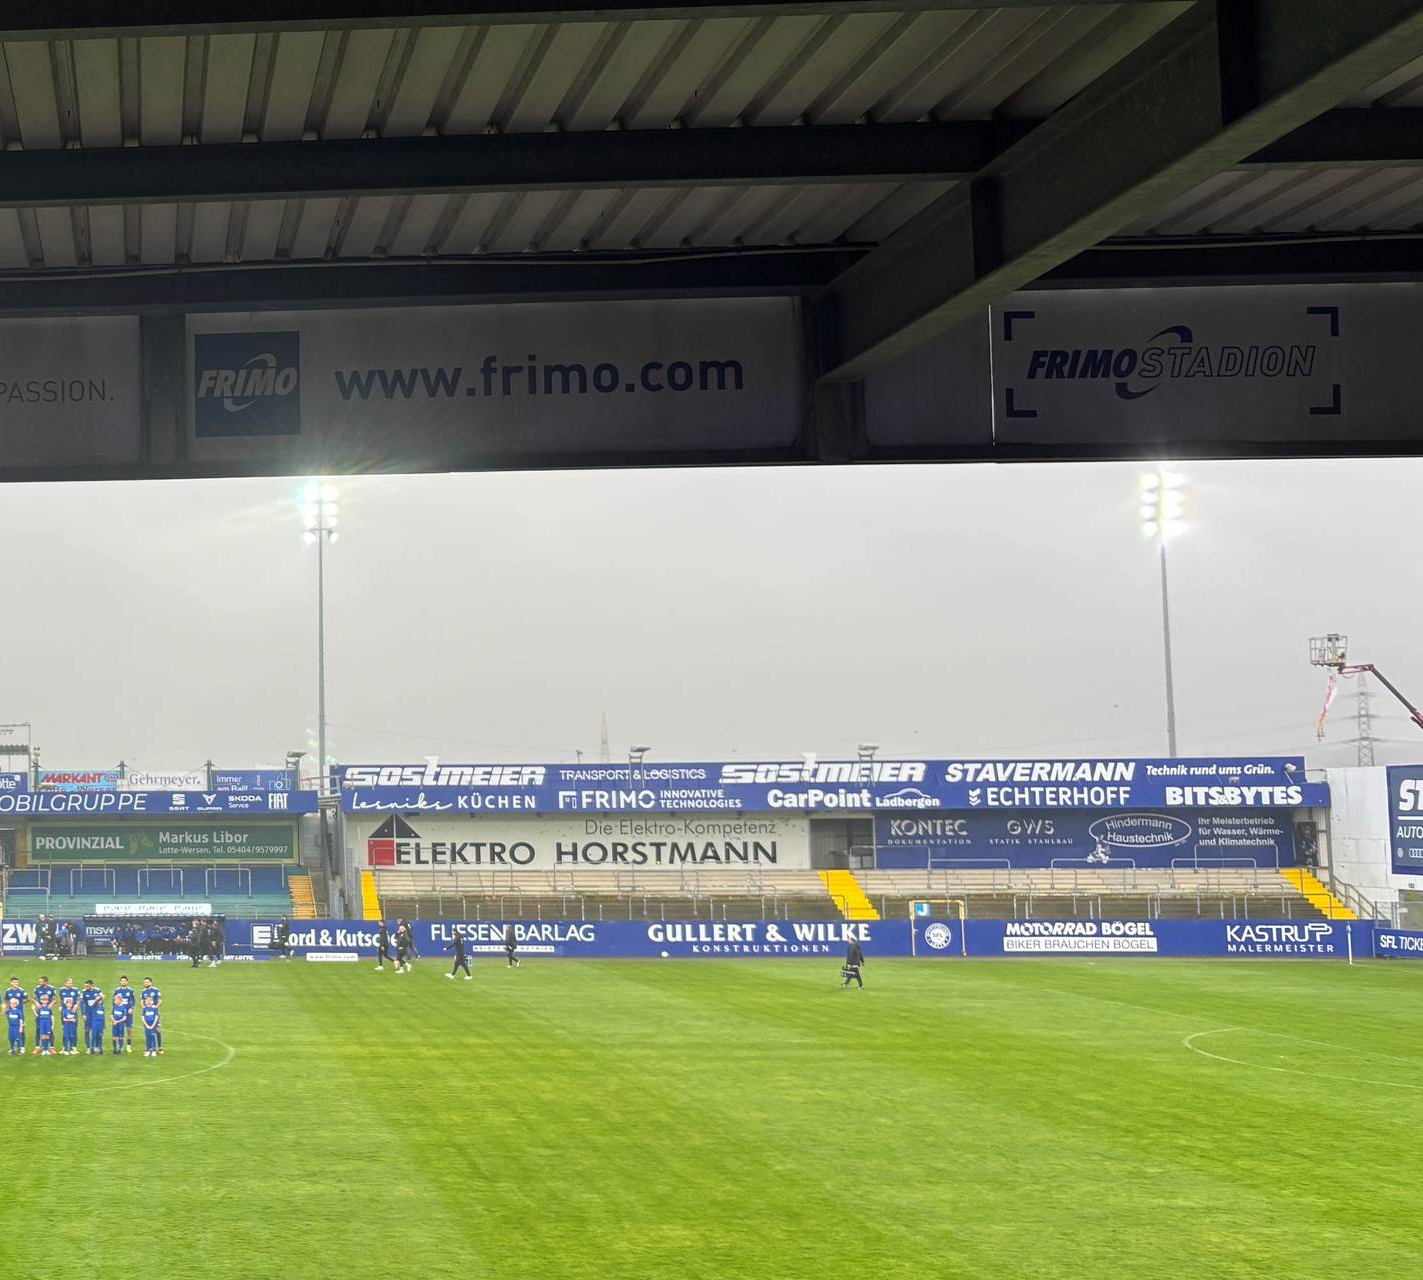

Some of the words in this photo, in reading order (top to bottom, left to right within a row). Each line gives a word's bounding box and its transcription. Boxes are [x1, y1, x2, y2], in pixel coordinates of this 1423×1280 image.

[197, 367, 298, 399] FRIMO
[334, 353, 745, 401] www.frimo.com
[559, 770, 630, 781] TRANSPORT
[633, 770, 640, 780] &
[643, 769, 706, 780] LOGISTICS
[945, 762, 1135, 782] STAVERMANN
[1146, 764, 1188, 776] Technik
[1190, 764, 1216, 776] rund
[1219, 767, 1241, 776] ums
[1243, 764, 1275, 775] Grün.
[41, 772, 102, 784] MARKANT
[581, 790, 656, 809] FRIMO
[660, 789, 724, 798] INNOVATIVE
[767, 788, 871, 808] CarPoint
[987, 786, 1131, 805] ECHTERHOFF
[268, 793, 288, 809] FIAT
[457, 793, 536, 809] KÜCHEN
[660, 799, 742, 808] TECHNOLOGIES
[875, 796, 940, 809] Ladbergen
[585, 819, 613, 836] Die
[620, 817, 777, 839] Elektro-Kompetenz
[890, 819, 968, 835] KONTEC
[1007, 819, 1055, 835] GWS
[1105, 817, 1173, 831] Hindermann
[1198, 817, 1210, 825] Ihr
[1212, 817, 1275, 825] Meisterbetrieb
[159, 831, 209, 843] Markus
[213, 831, 248, 843] Libor
[1107, 831, 1174, 844] Haustechnik
[1198, 827, 1211, 836] für
[1249, 827, 1284, 836] Wärme-
[36, 836, 124, 850] PROVINZIAL
[1199, 837, 1217, 846] und
[1218, 837, 1276, 846] Klimatechnik
[159, 846, 211, 855] Lotte-Wersen,
[212, 845, 224, 854] Tel.
[396, 841, 536, 865] ELEKTRO
[555, 841, 778, 865] HORSTMANN
[515, 923, 595, 942] BARLAG
[647, 923, 756, 943] GULLERT
[765, 923, 787, 942] &
[793, 923, 872, 942] WILKE
[1006, 922, 1097, 936] MOTORRAD
[1101, 920, 1154, 935] BÖGEL
[1227, 923, 1333, 942] KASTRUP
[320, 929, 333, 947] &
[1006, 940, 1041, 950] BIKER
[1044, 940, 1111, 950] BRAUCHEN
[1113, 938, 1154, 949] BÖGEL
[1380, 935, 1398, 949] SFL
[692, 944, 829, 952] KONSTRUKTIONEN
[1227, 944, 1334, 952] MALERMEISTER
